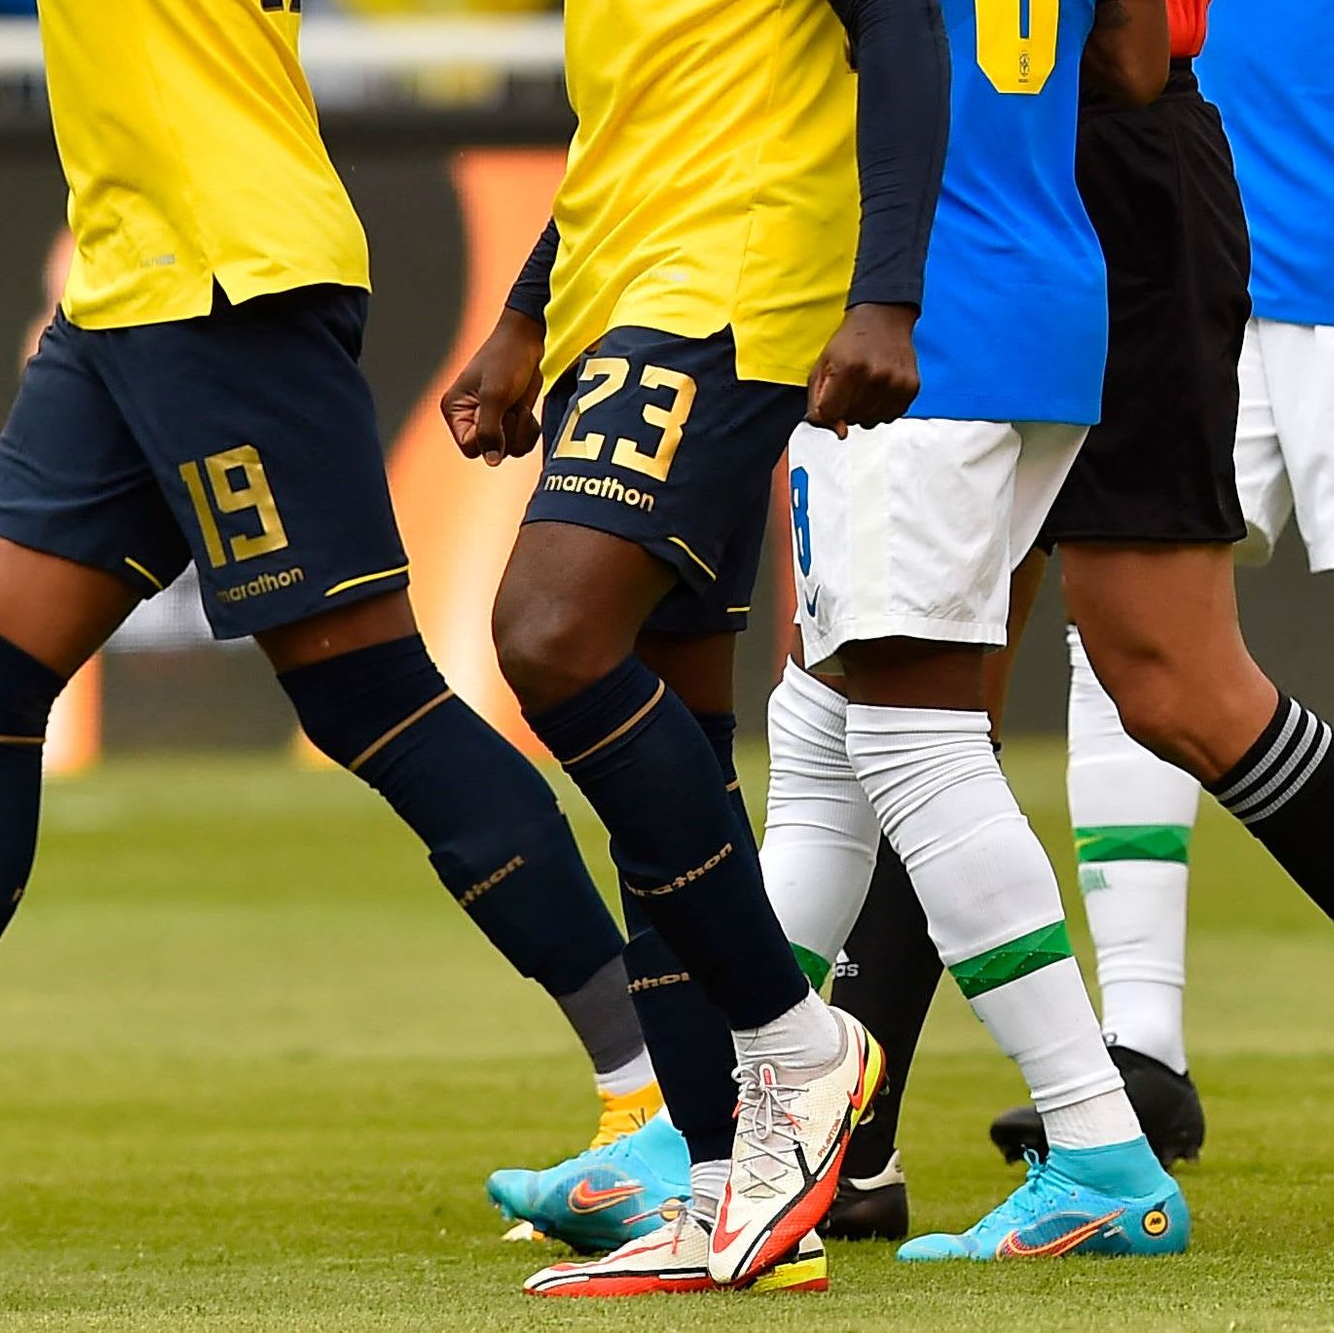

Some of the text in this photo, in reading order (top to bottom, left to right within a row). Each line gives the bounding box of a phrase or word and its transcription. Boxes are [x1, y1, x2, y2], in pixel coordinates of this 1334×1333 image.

[552, 357, 698, 483] 23
[178, 444, 289, 569] 19
[543, 474, 655, 512] marathon
[217, 566, 305, 604] marathon
